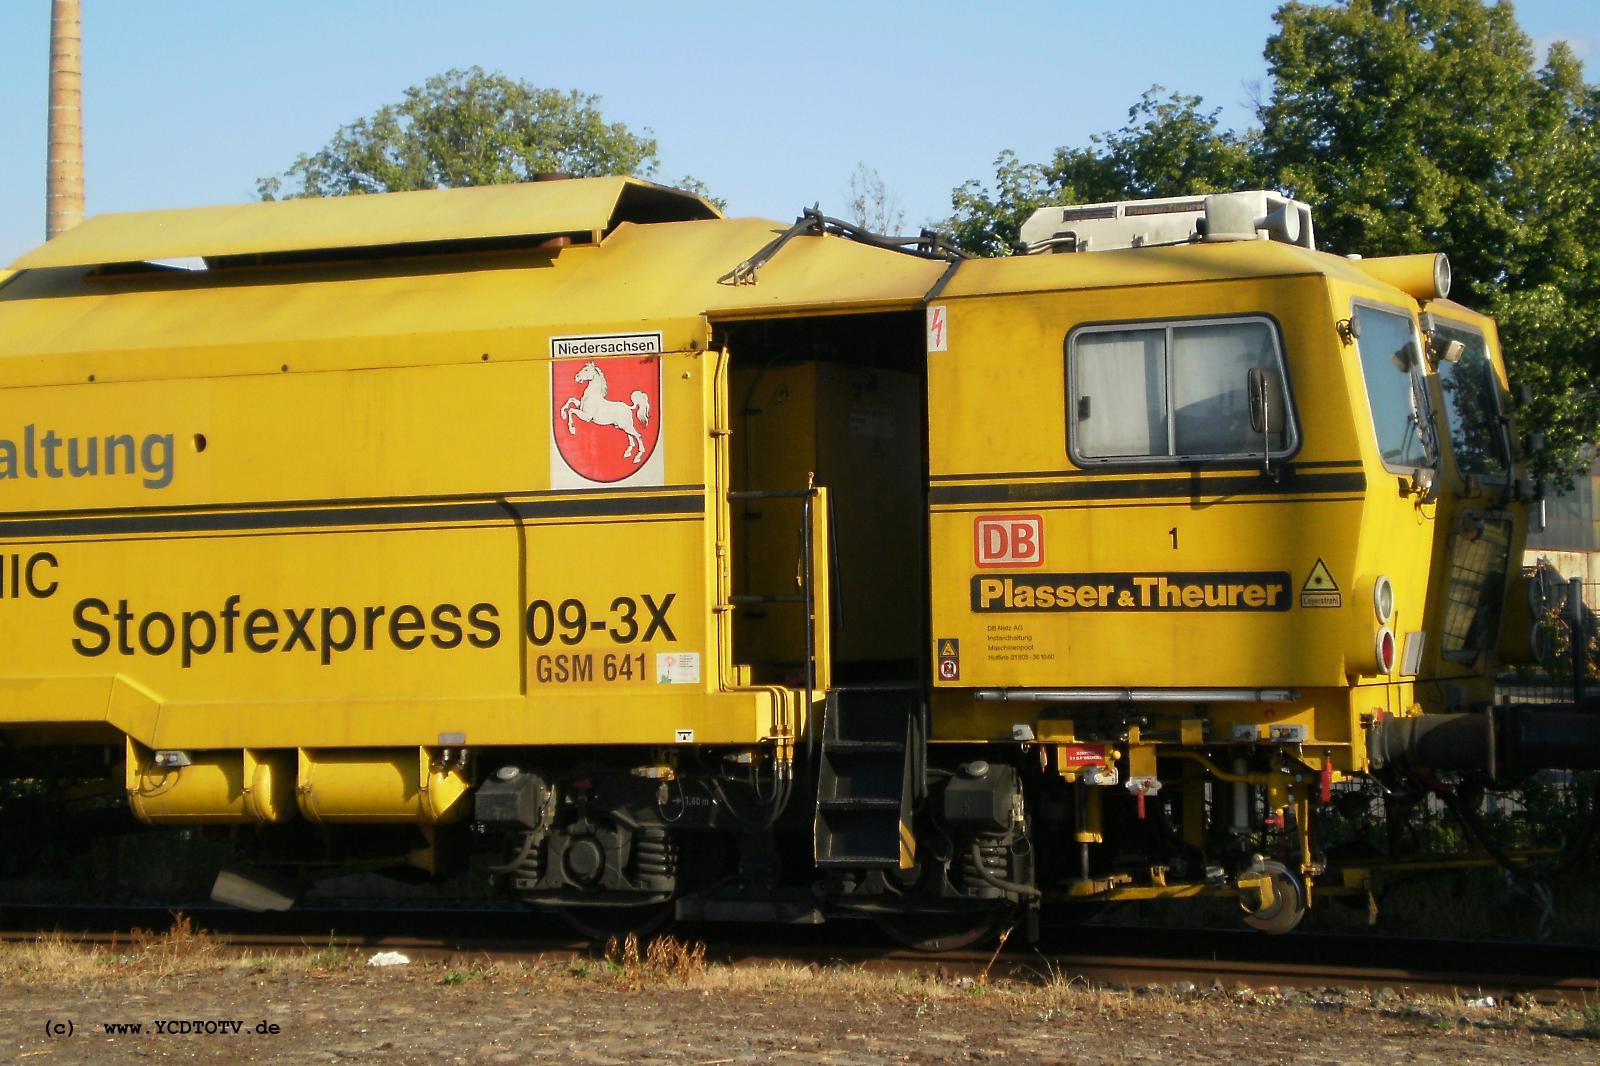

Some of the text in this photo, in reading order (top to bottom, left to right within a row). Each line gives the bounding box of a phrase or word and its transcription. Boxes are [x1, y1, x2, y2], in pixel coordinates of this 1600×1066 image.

[558, 341, 654, 355] Niedersachsen
[0, 423, 174, 489] altung
[983, 523, 1036, 560] DB
[1168, 527, 1179, 550] 1
[0, 551, 59, 599] IC
[71, 593, 678, 668] Stopfexpress 09-3X
[536, 654, 593, 683] GSM
[603, 653, 646, 681] 641
